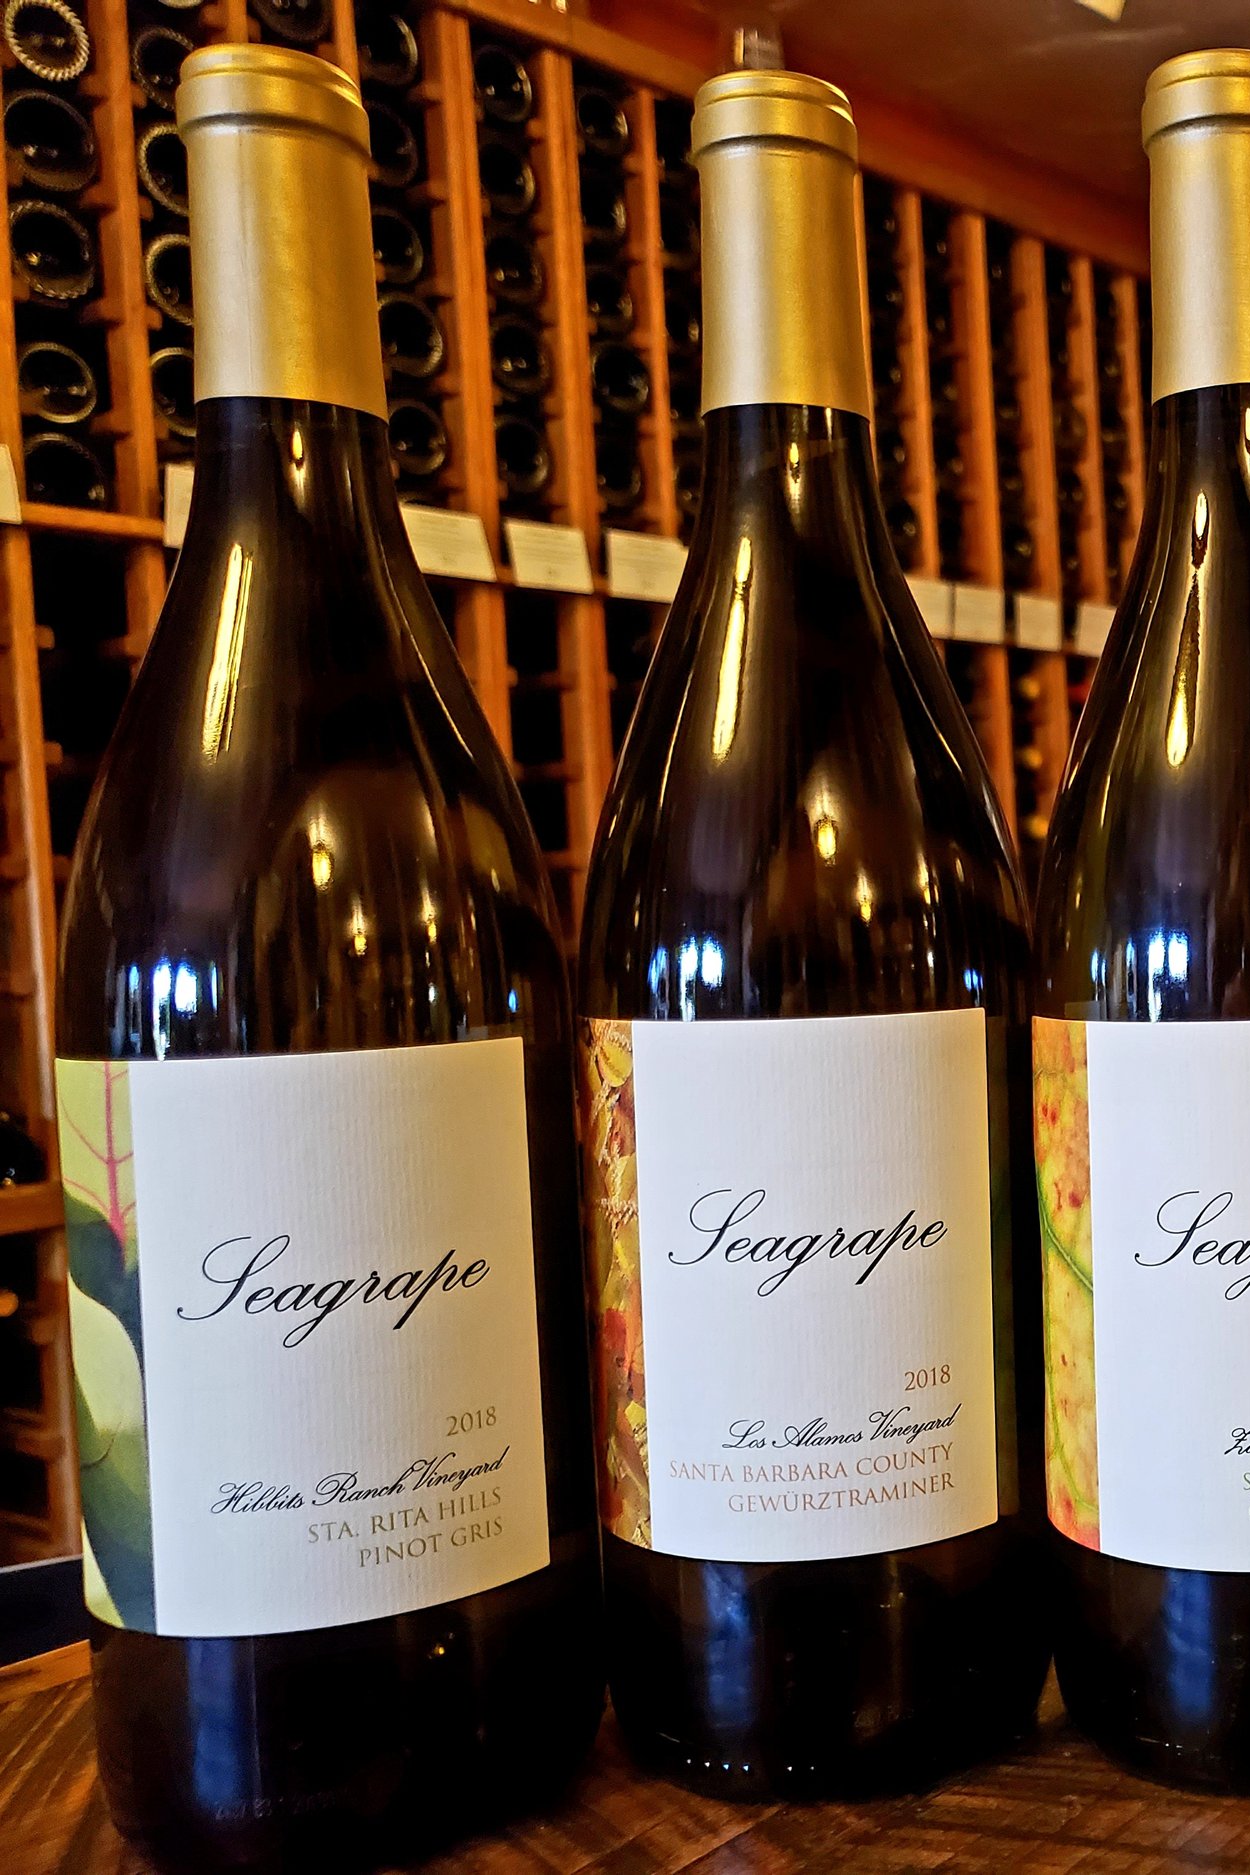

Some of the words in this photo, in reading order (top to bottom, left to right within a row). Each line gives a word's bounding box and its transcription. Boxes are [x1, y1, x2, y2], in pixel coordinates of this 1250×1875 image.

[668, 1189, 948, 1297] Seagrape
[177, 1235, 491, 1348] Seagrape
[904, 1364, 951, 1391] 2018
[445, 1406, 497, 1437] 2018
[722, 1419, 767, 1449] Los
[772, 1417, 864, 1448] Alamos
[868, 1403, 962, 1445] Vineyard
[210, 1481, 304, 1515] Hibbits
[312, 1465, 411, 1506] Ranch
[409, 1445, 510, 1492] Vineyard
[669, 1460, 734, 1482] SANTA
[743, 1461, 848, 1483] BARBARA
[856, 1442, 954, 1476] COUNTY
[308, 1521, 359, 1543] STA.
[371, 1507, 429, 1535] RITA
[438, 1486, 502, 1520] HILLS
[728, 1472, 955, 1513] GEWÜRZTRAMINER
[359, 1533, 442, 1567] PINOT
[450, 1515, 503, 1547] GRIS
